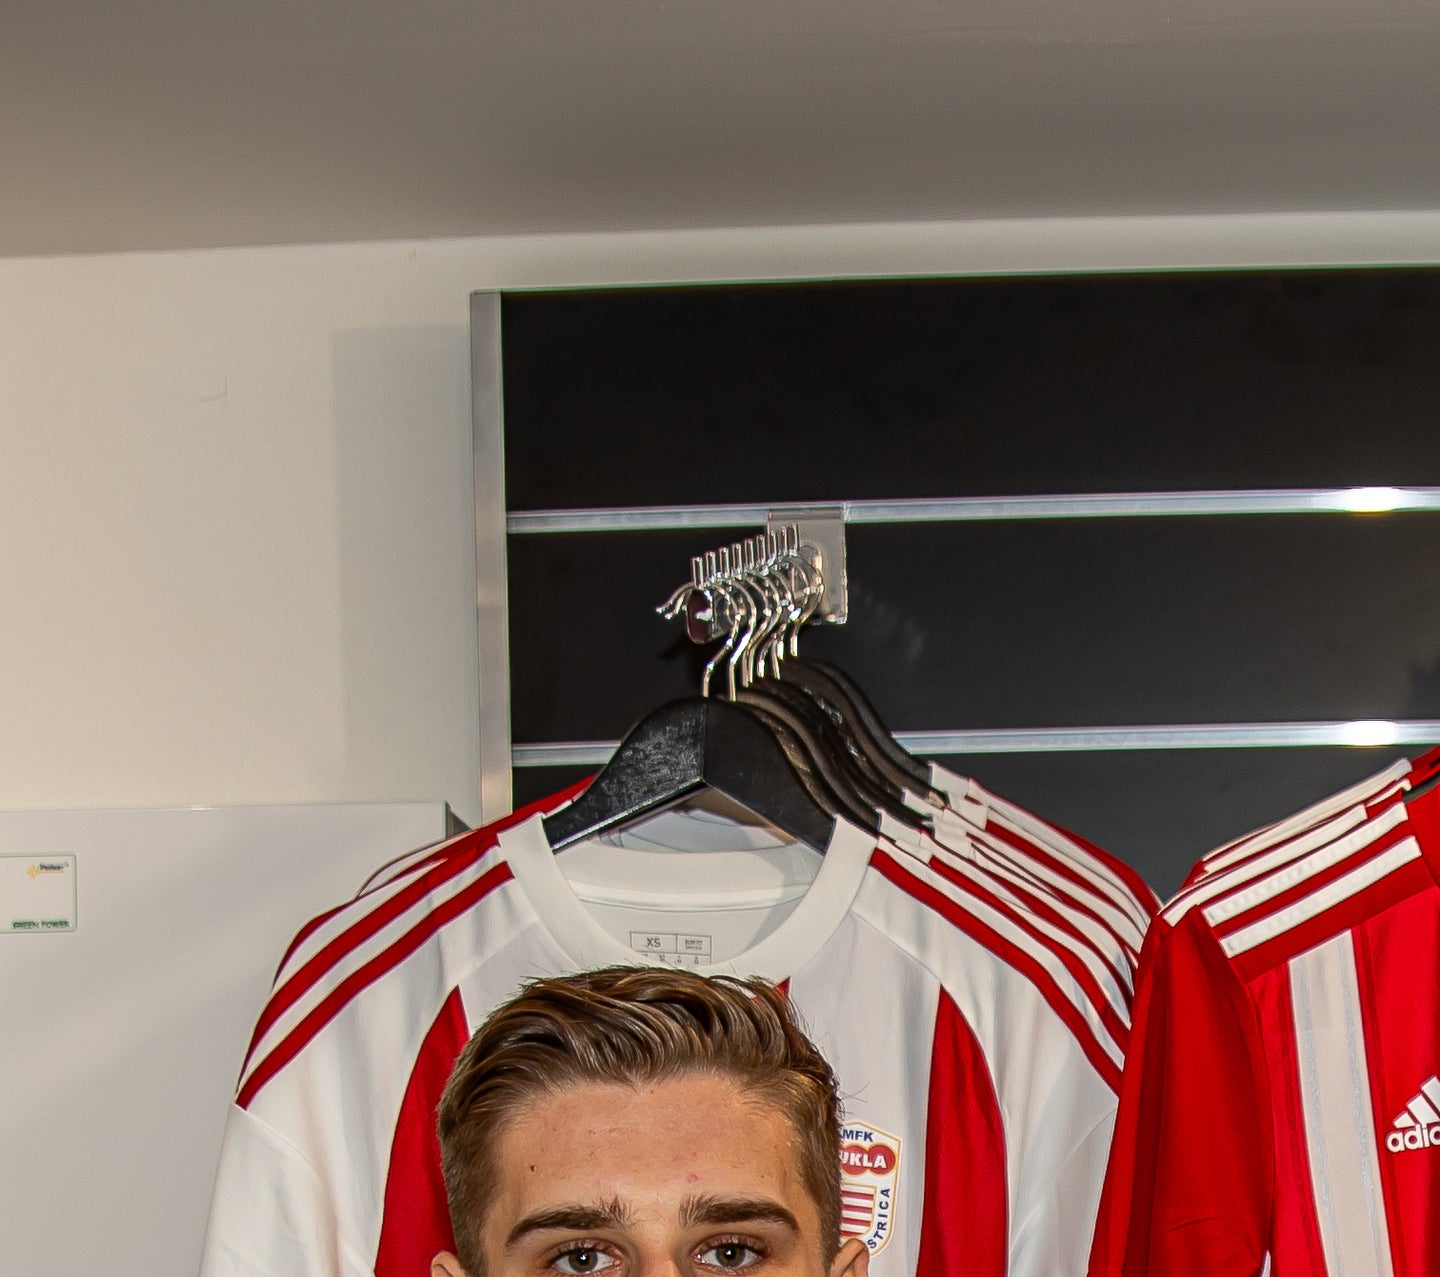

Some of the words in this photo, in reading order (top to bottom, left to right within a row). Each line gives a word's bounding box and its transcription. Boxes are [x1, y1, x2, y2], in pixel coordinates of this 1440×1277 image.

[646, 937, 662, 949] XS
[841, 1128, 874, 1142] MFK
[839, 1152, 887, 1169] UKLA
[867, 1188, 891, 1249] STRICA
